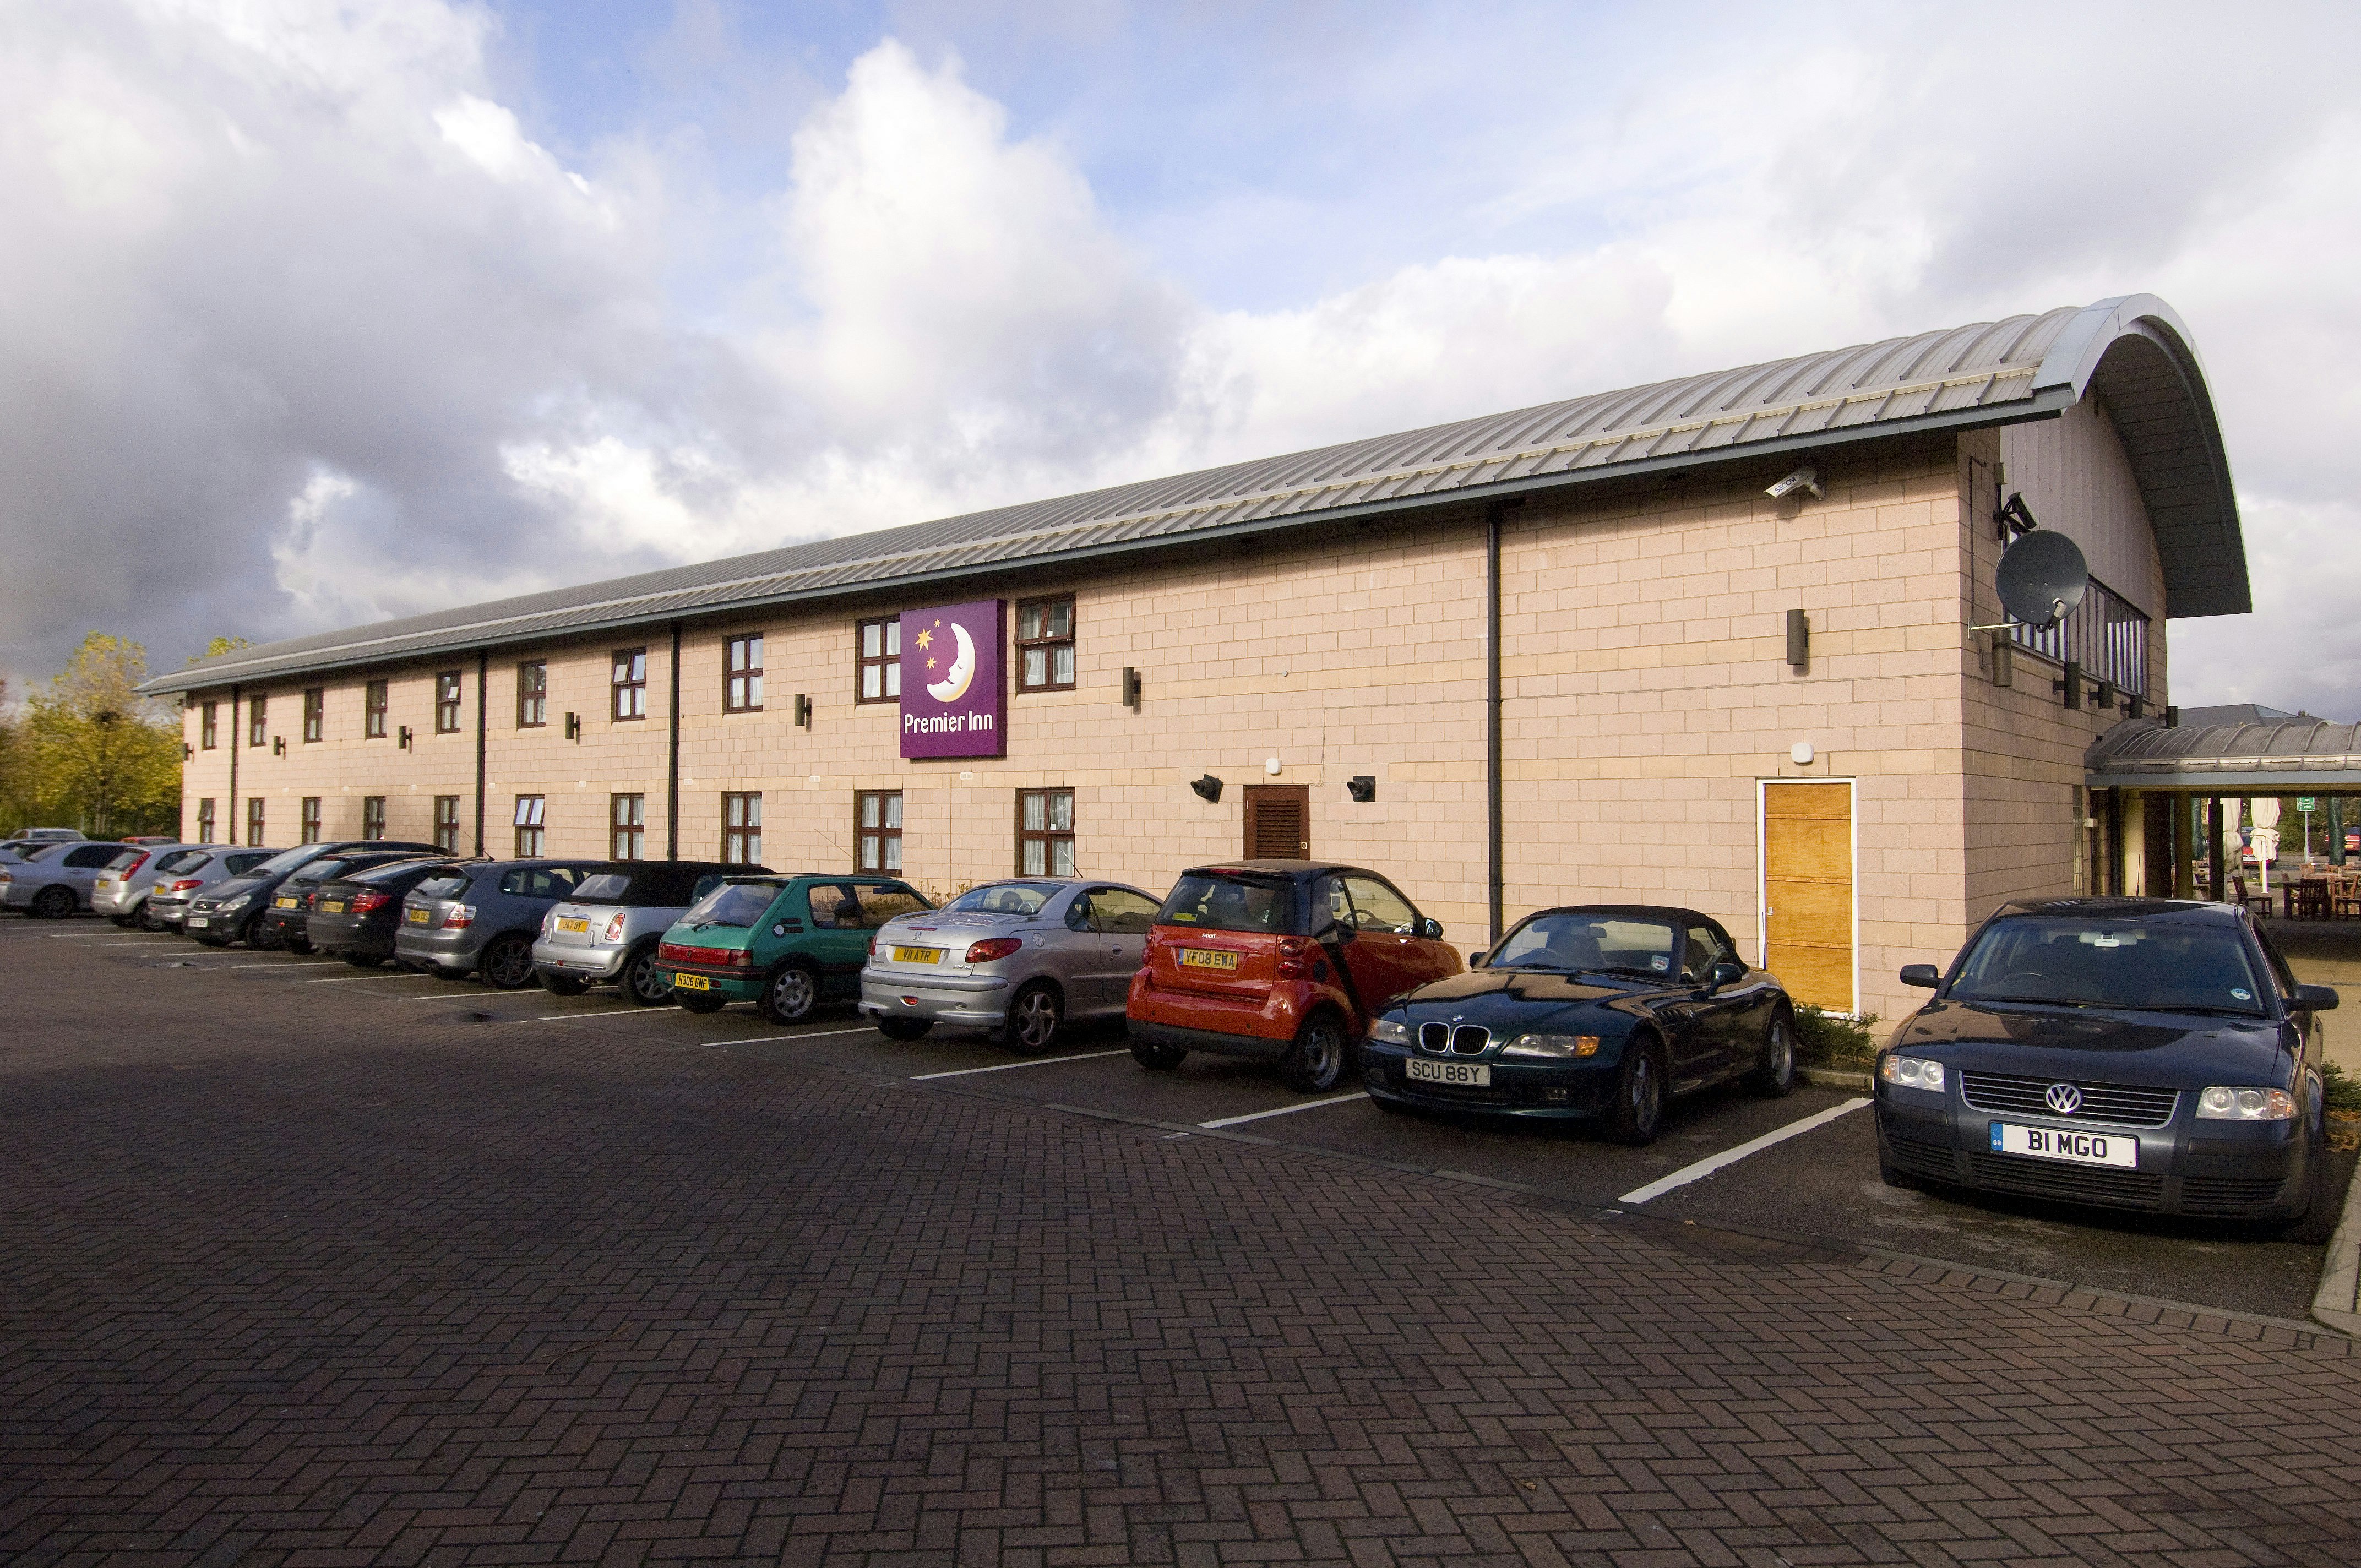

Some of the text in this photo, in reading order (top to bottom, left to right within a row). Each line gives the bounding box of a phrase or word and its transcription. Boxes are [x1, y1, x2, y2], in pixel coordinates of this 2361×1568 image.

[1775, 476, 1796, 493] SECOM
[904, 710, 993, 734] Premier Inn
[913, 950, 931, 961] ATR
[1186, 951, 1234, 967] YF08 EWA
[678, 974, 707, 988] H306 GNF
[1412, 1061, 1480, 1082] SCU 88Y
[2028, 1130, 2107, 1158] B1 MGO
